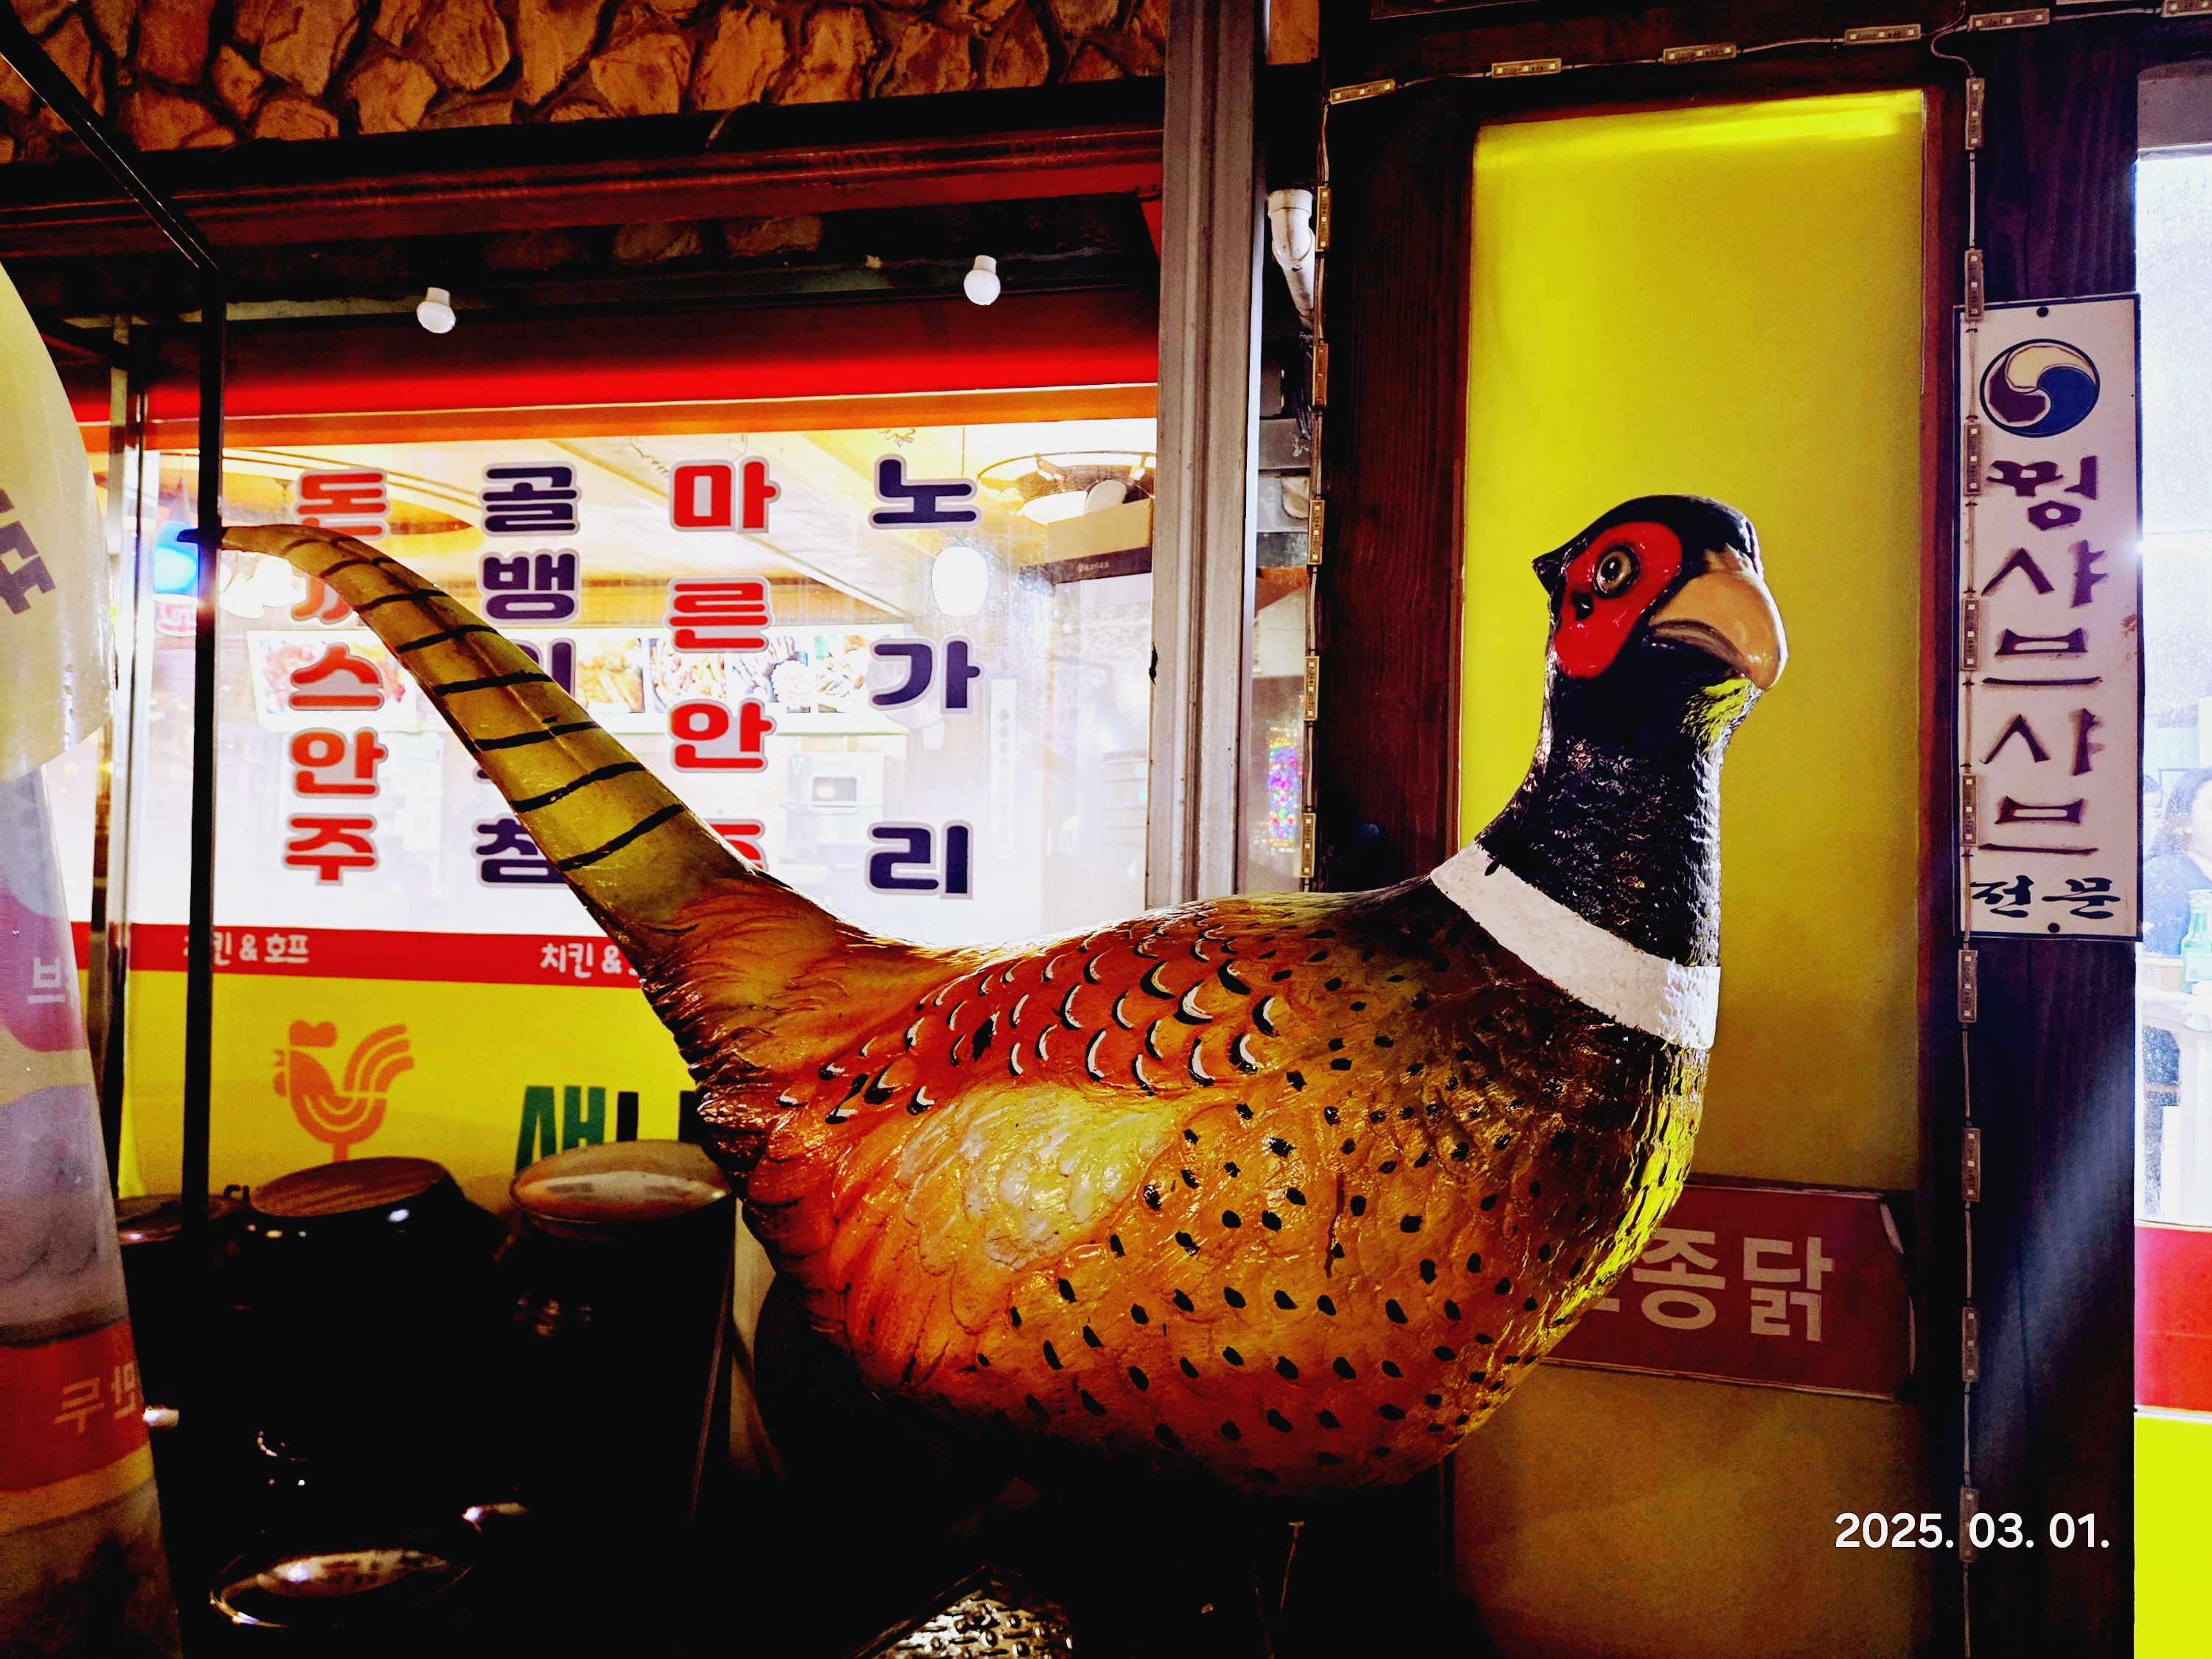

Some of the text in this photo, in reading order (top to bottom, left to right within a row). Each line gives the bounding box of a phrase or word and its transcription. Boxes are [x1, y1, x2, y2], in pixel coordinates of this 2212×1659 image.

[869, 457, 982, 895] 노가리
[1969, 874, 2121, 919] 전문
[238, 933, 259, 962] &
[263, 932, 310, 964] 호프
[540, 942, 623, 979] 치킨 &
[1589, 1226, 1835, 1343] 종닭
